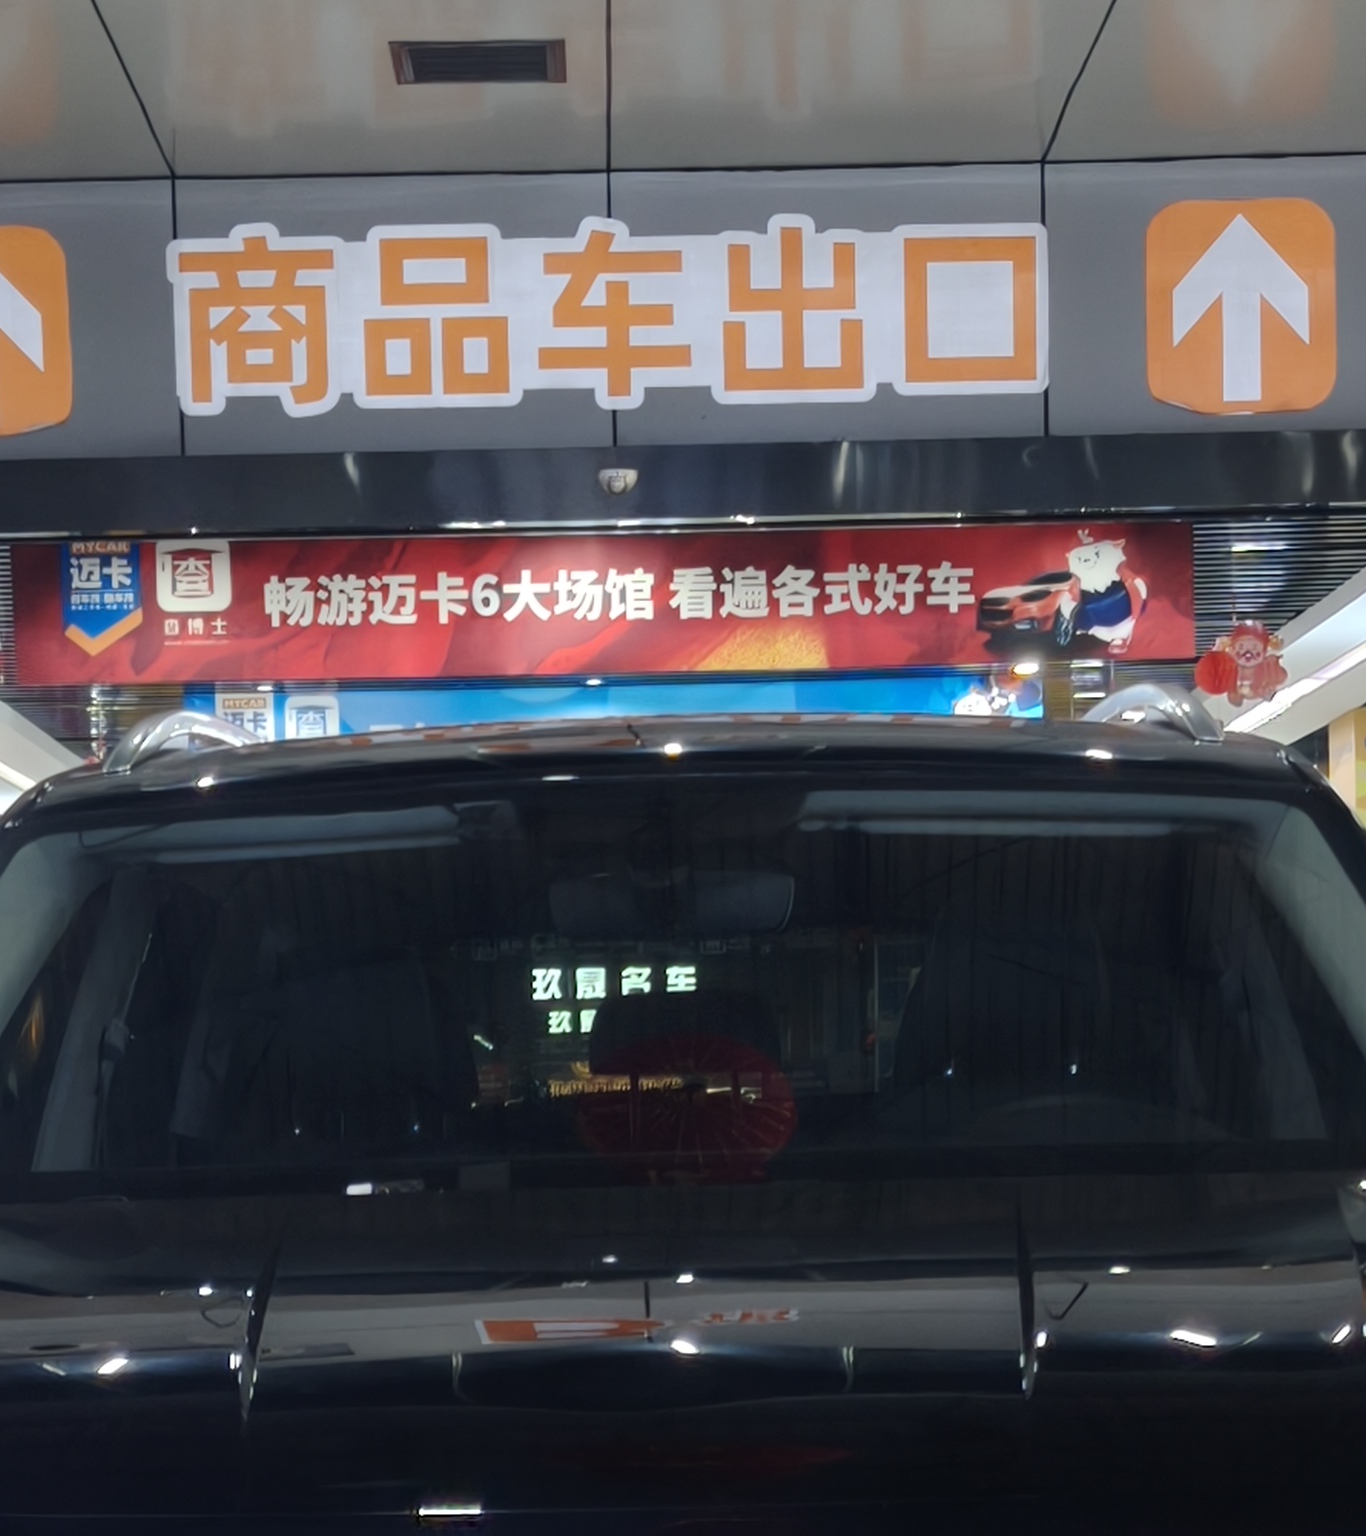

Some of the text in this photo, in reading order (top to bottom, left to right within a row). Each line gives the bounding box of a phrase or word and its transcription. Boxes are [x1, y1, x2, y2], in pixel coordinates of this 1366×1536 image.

[175, 223, 1041, 409] 商品车出口
[70, 557, 133, 589] 迈卡
[263, 560, 976, 629] 畅游迈卡6大场馆 看遍各式好车
